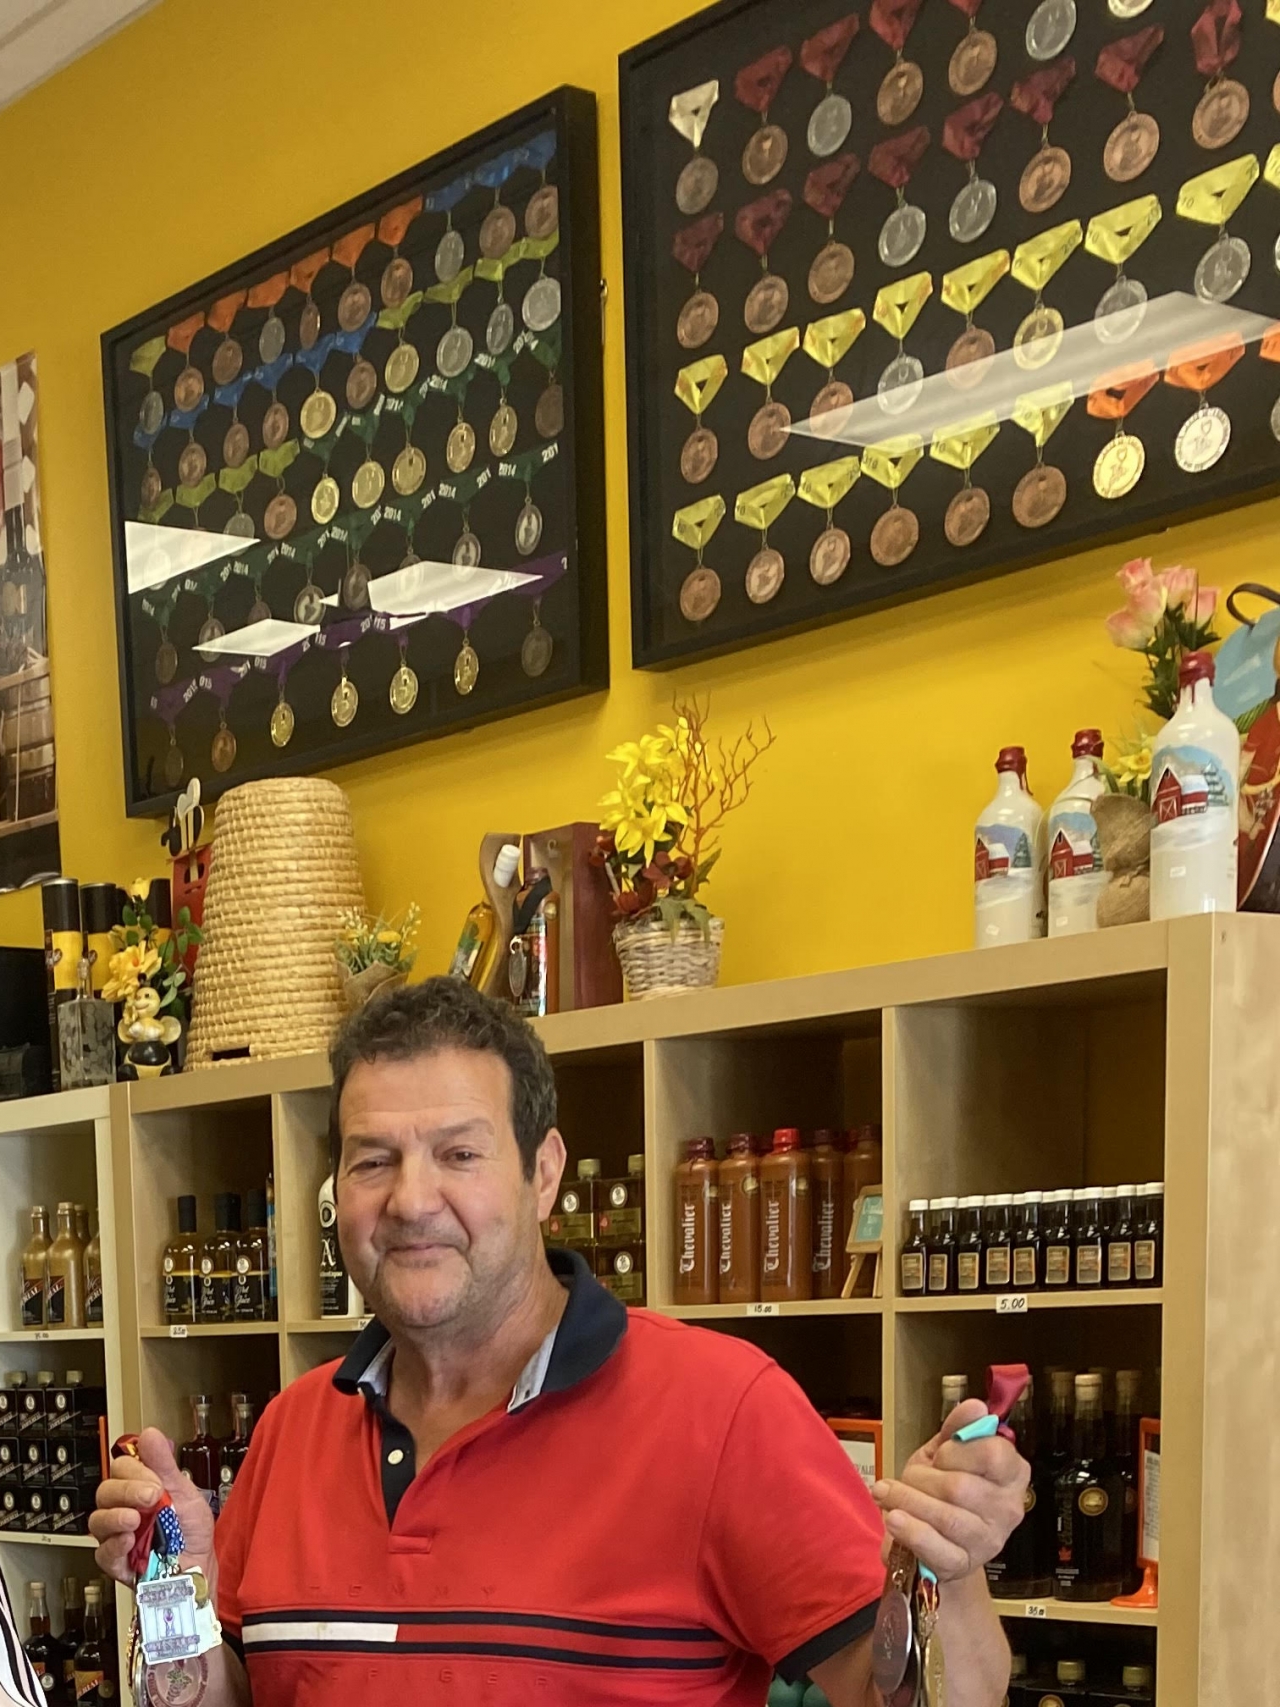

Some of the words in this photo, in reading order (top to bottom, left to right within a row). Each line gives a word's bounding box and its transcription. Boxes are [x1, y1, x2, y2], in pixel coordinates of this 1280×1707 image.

[438, 482, 457, 499] 2014
[384, 506, 402, 522] 2014
[233, 560, 249, 576] 2014
[679, 1202, 696, 1274] Chevalier
[764, 1200, 780, 1273] Chevalier
[1000, 1297, 1026, 1311] 5.00
